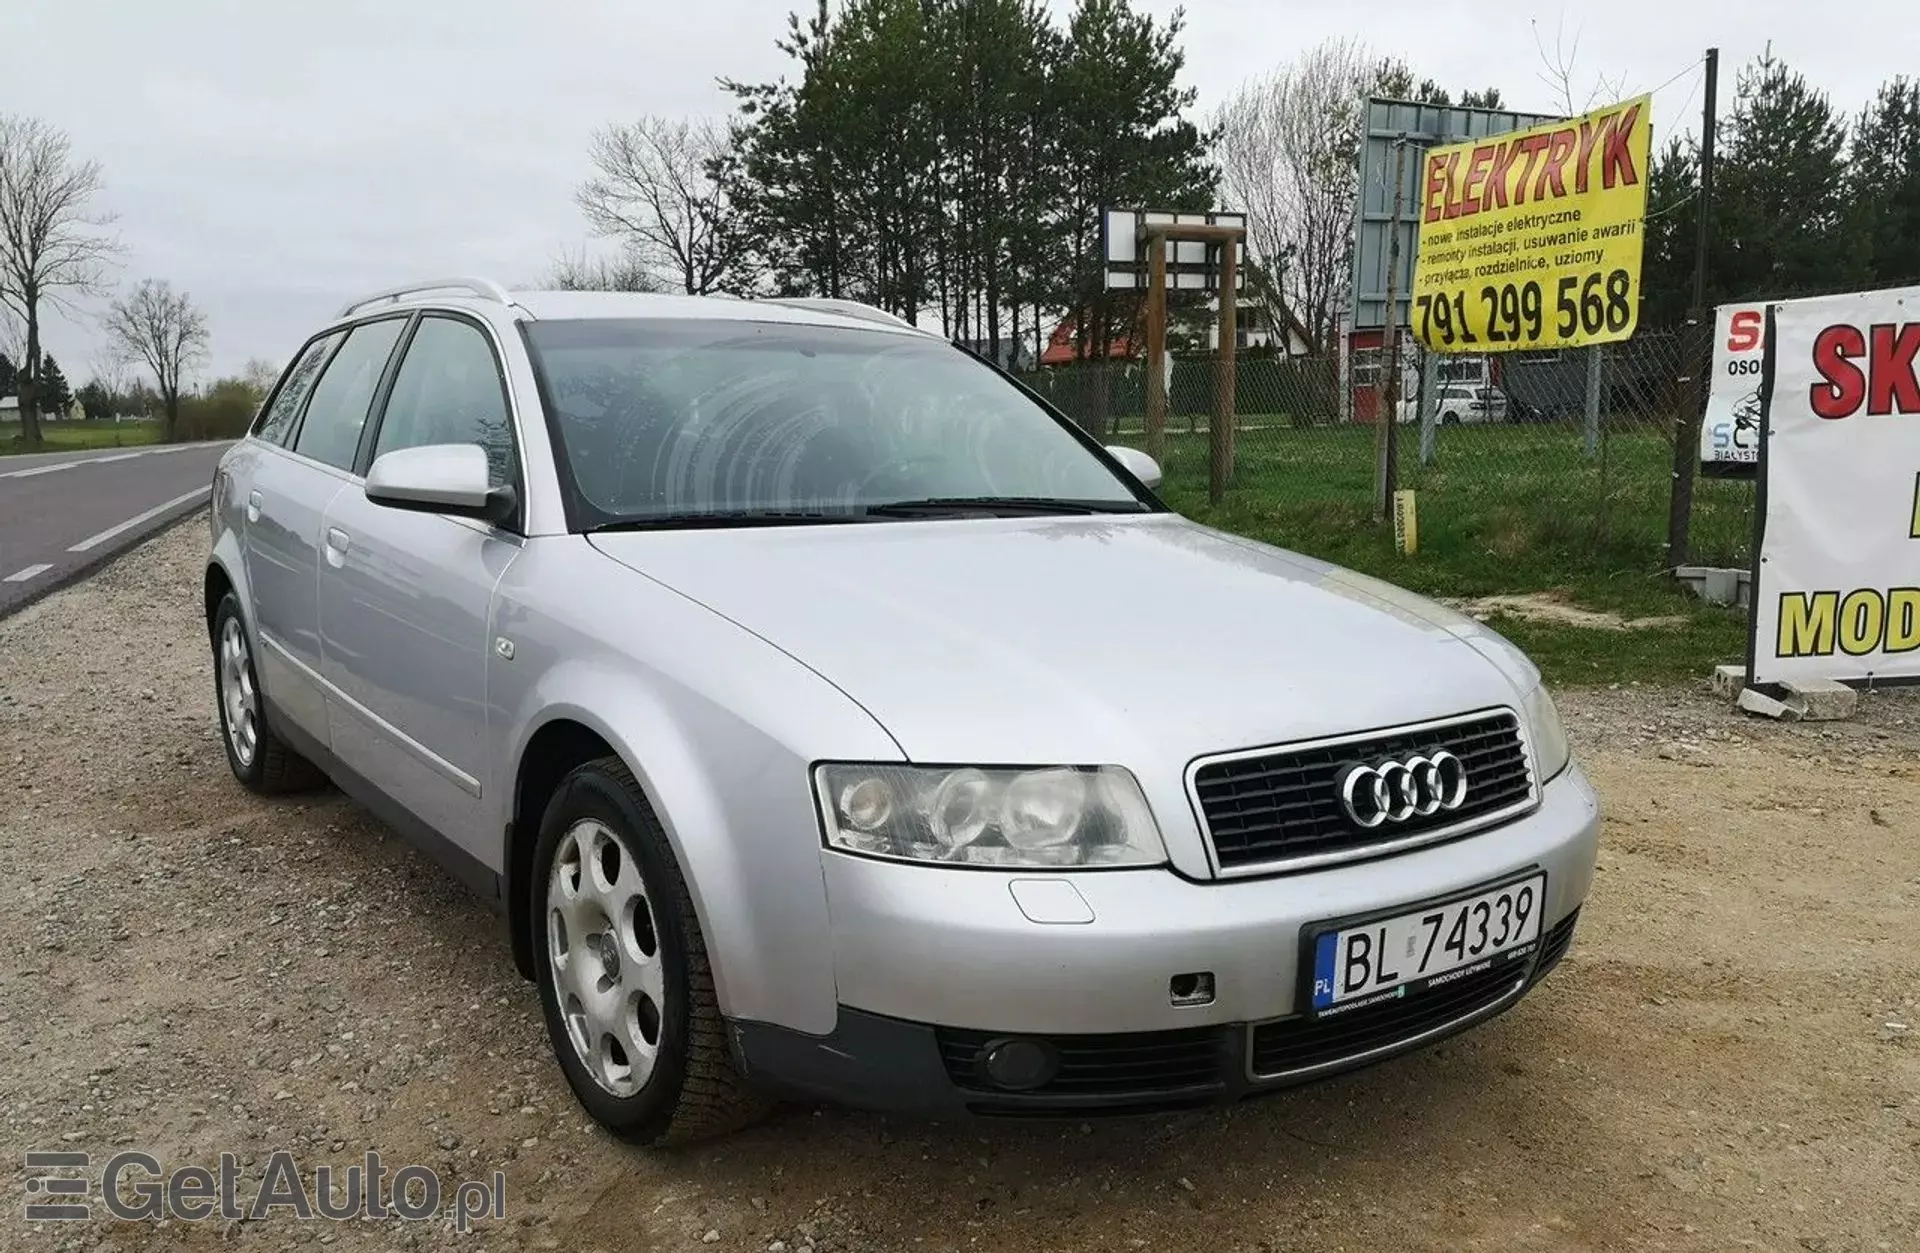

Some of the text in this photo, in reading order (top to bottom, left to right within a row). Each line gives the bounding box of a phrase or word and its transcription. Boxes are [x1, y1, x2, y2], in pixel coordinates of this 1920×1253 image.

[1424, 103, 1642, 224] ELEKTRYK
[1428, 209, 1581, 246] nowe instalacje elektryczne
[1428, 219, 1636, 265] remonty instalacji, usuwanie awarii
[1474, 257, 1549, 277] rozdzielnice,
[1555, 248, 1604, 265] uziomy
[1415, 268, 1631, 346] 791 299 568
[1727, 310, 1764, 351] S
[1728, 359, 1762, 375] OSO
[1775, 586, 1920, 659] MOD
[1344, 886, 1533, 994] BL 74339
[1314, 978, 1331, 997] PL
